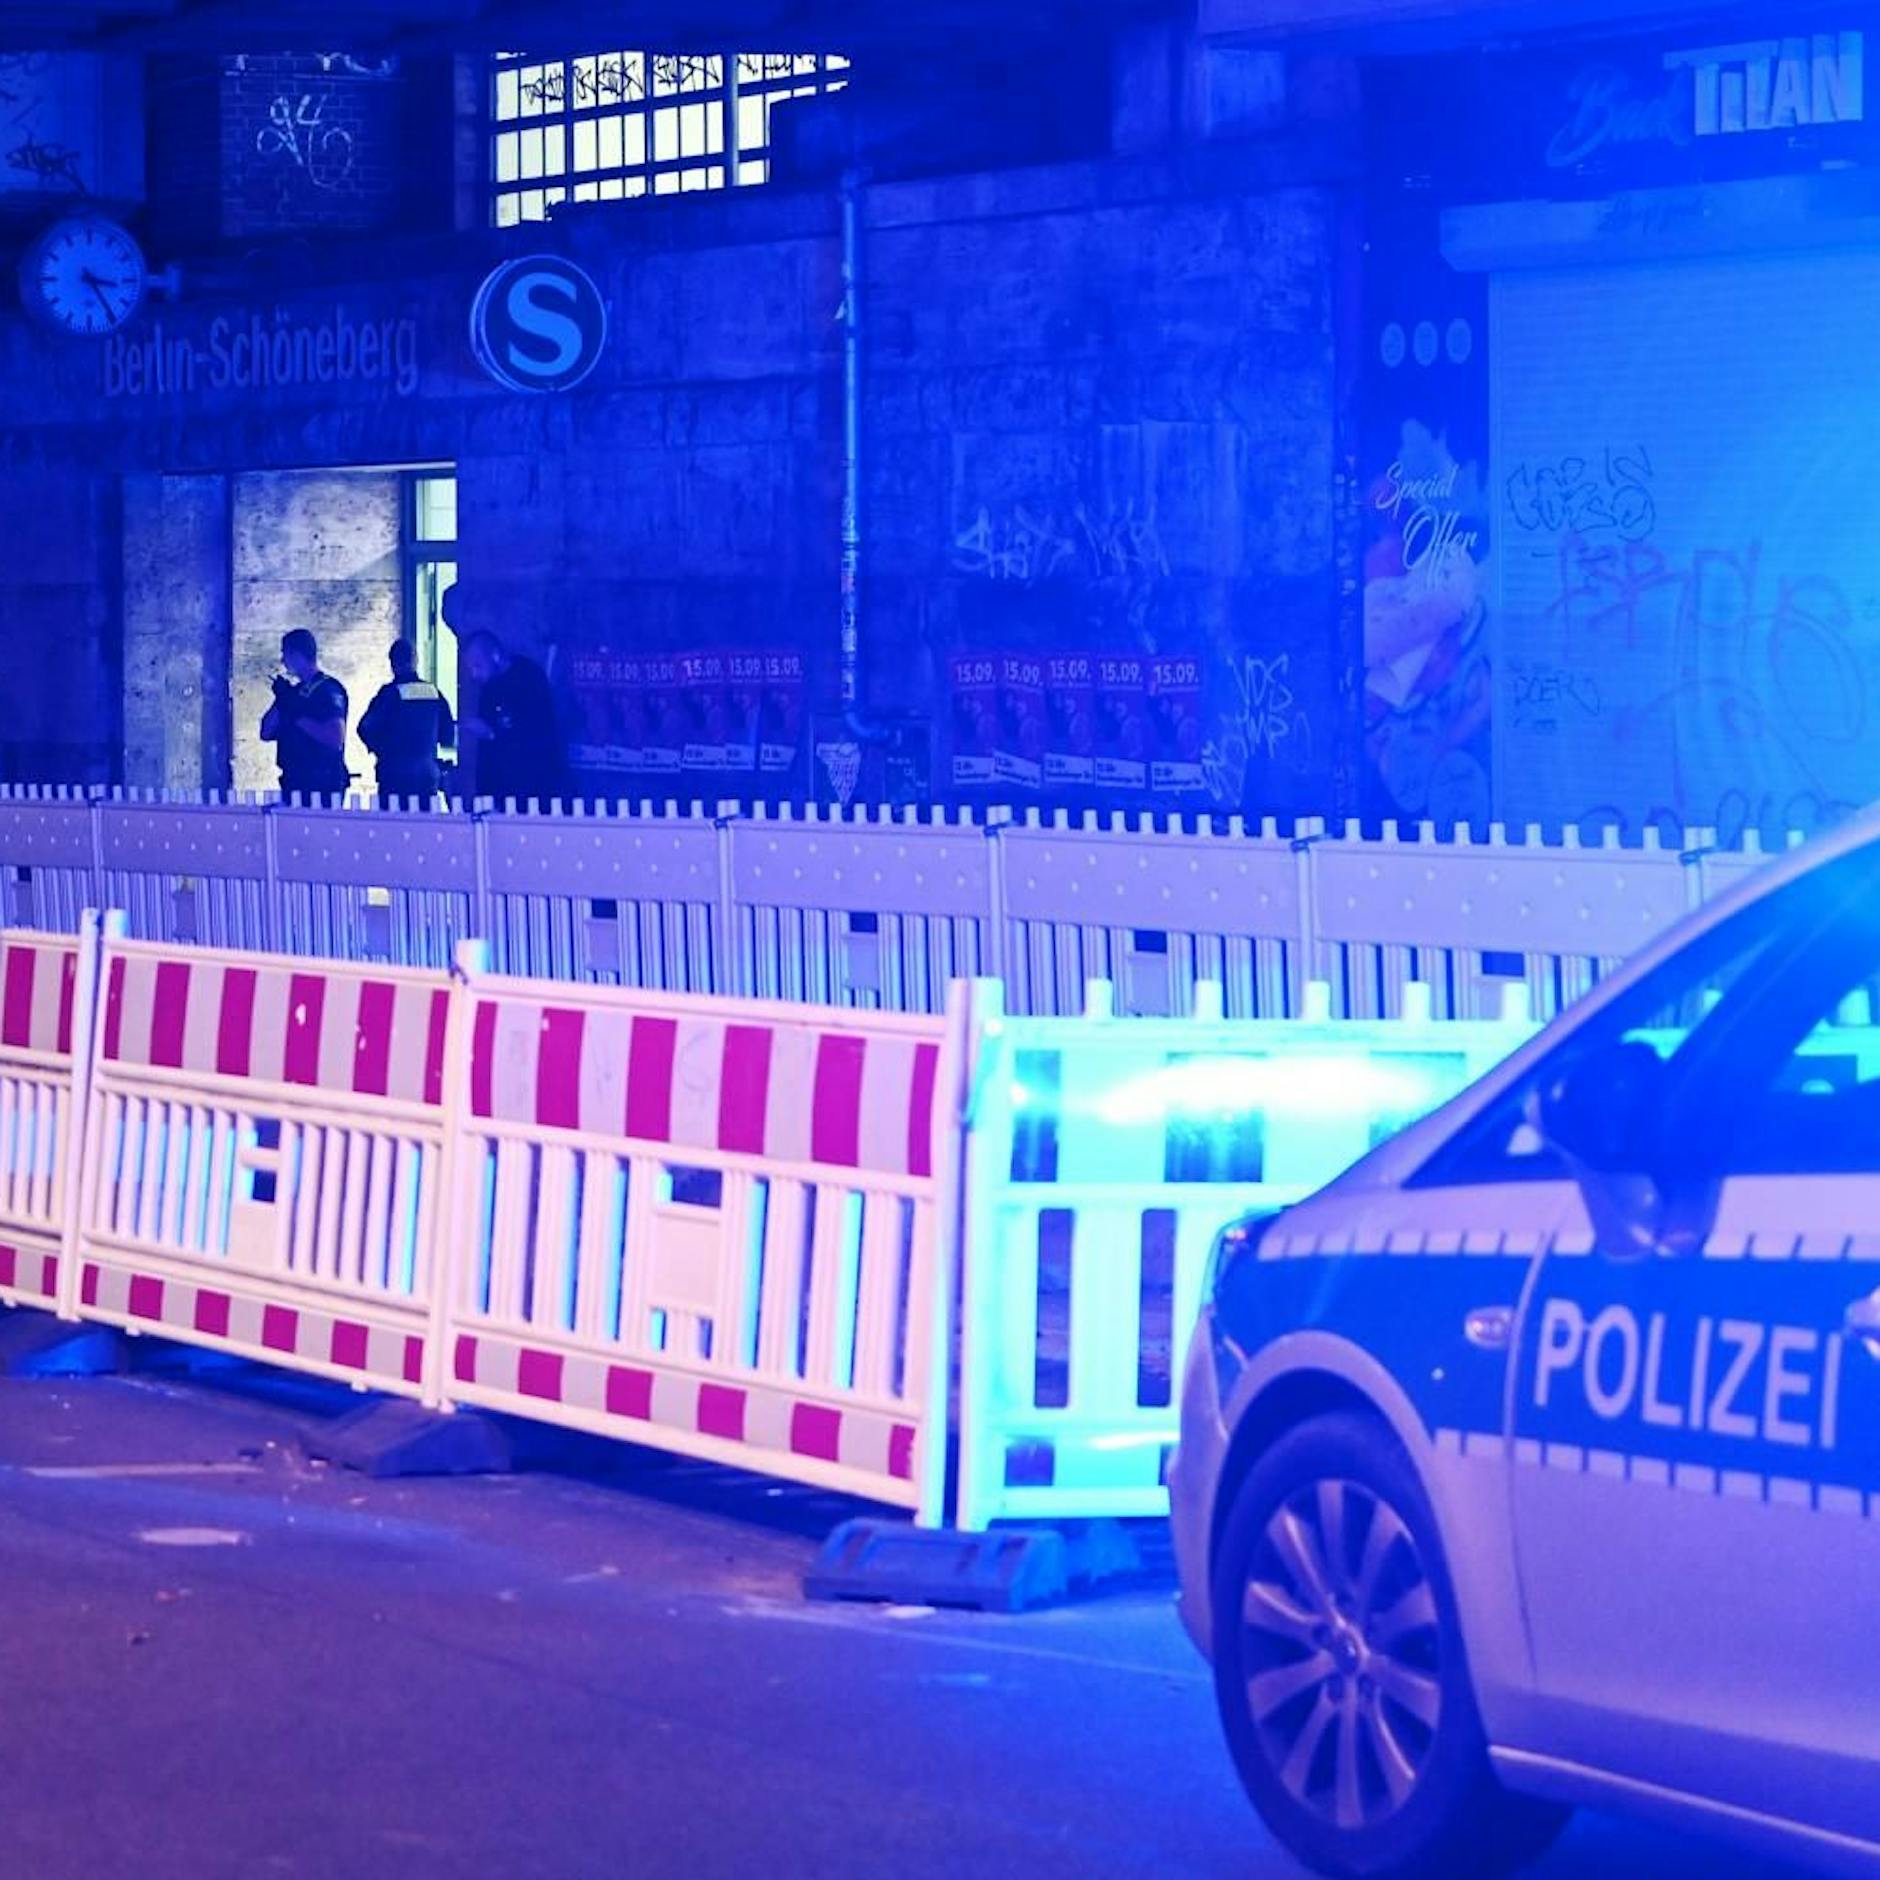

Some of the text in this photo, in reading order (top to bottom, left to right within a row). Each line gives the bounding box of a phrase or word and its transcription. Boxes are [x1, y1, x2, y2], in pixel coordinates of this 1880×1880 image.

[103, 304, 418, 398] Berlin-Schöneberg
[1376, 461, 1459, 520] Special
[1403, 504, 1477, 590] Offer
[957, 662, 996, 683] 15.09.
[1002, 659, 1044, 686] 15.09.
[1049, 658, 1091, 681] 15.09.
[1100, 661, 1143, 683] 15.09.
[1153, 662, 1199, 684] 15.09.
[1533, 1298, 1842, 1450] POLIZEI
